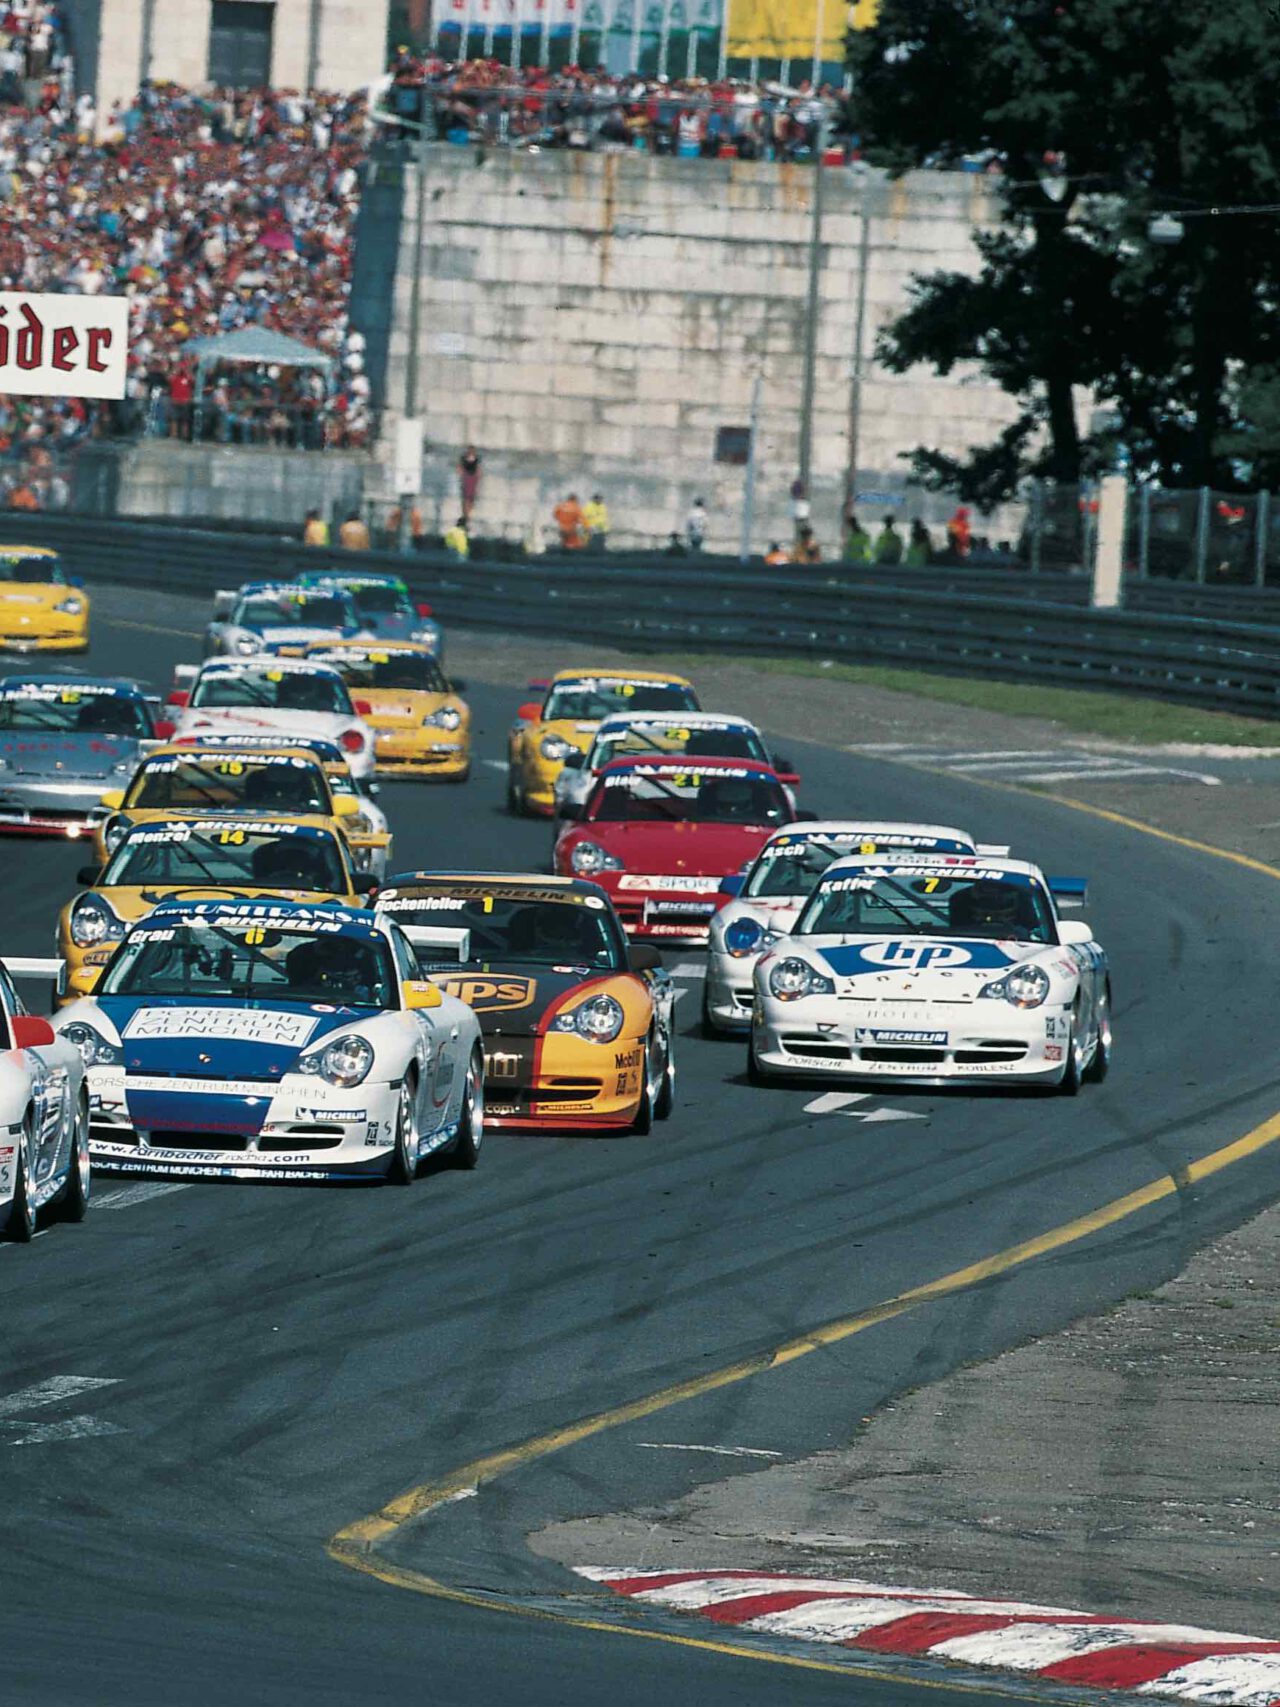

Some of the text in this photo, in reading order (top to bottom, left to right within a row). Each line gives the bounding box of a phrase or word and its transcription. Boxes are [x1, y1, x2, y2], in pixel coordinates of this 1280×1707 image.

[200, 754, 288, 765] MICHELIN
[657, 765, 749, 778] MICHELIN
[673, 774, 701, 788] 21
[194, 821, 298, 834] MICHELIN
[128, 830, 192, 844] Menzel
[219, 830, 245, 845] 14
[833, 834, 938, 847] MICHELIN
[762, 842, 805, 859] Asch
[859, 842, 877, 855] 9
[892, 866, 1004, 881] MICHELIN
[819, 877, 878, 895] Kaffer
[924, 877, 939, 894] 7
[449, 887, 566, 901] MICHELIN
[373, 897, 467, 913] Rockenfeller
[482, 896, 494, 914] 1
[155, 904, 373, 926] www.UNITRANS.at
[214, 916, 343, 932] MICHELIN
[127, 928, 176, 944] Grau
[244, 926, 267, 945] 6
[882, 941, 954, 969] hp
[141, 1017, 301, 1033] ZENTRUM
[876, 1031, 947, 1043] MICHELIN
[315, 1110, 367, 1121] MICHELIN
